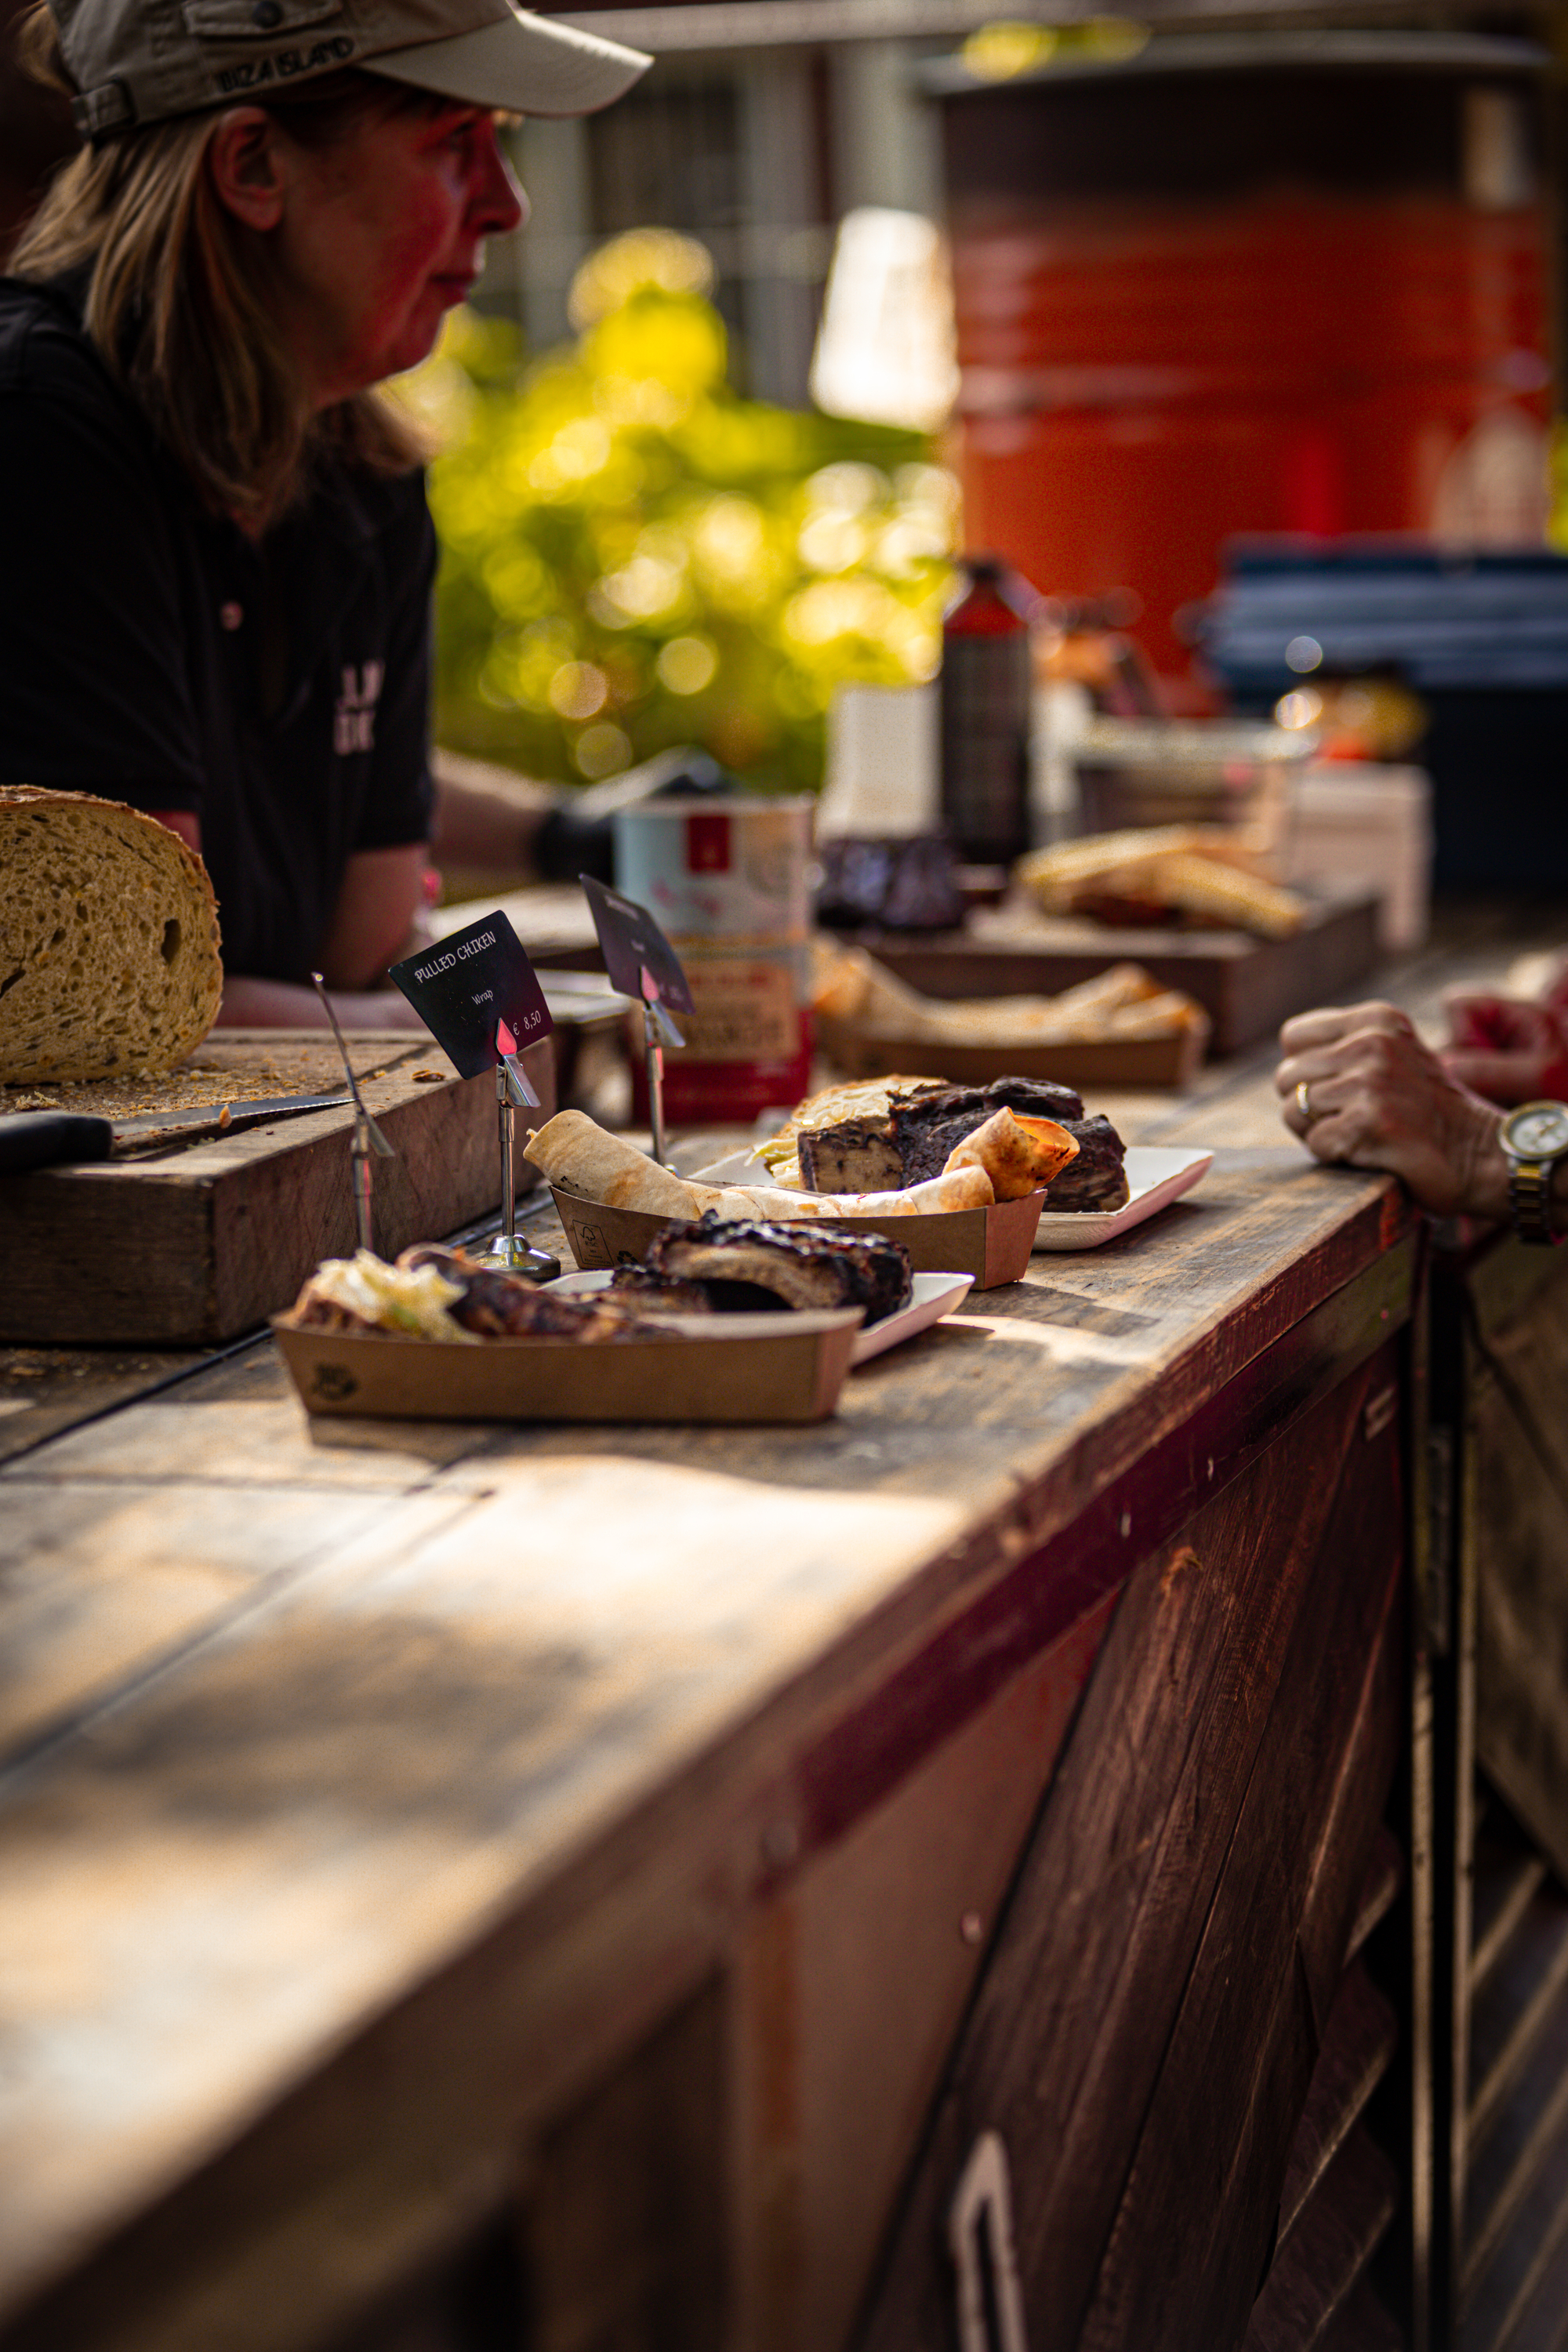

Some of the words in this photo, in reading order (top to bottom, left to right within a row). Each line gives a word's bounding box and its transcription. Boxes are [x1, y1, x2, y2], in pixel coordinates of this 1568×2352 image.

[414, 953, 456, 984] PULLED
[457, 931, 496, 960] CHIKEN
[471, 989, 494, 1005] Wrap
[513, 1022, 520, 1036] €
[523, 1010, 542, 1030] 8,50
